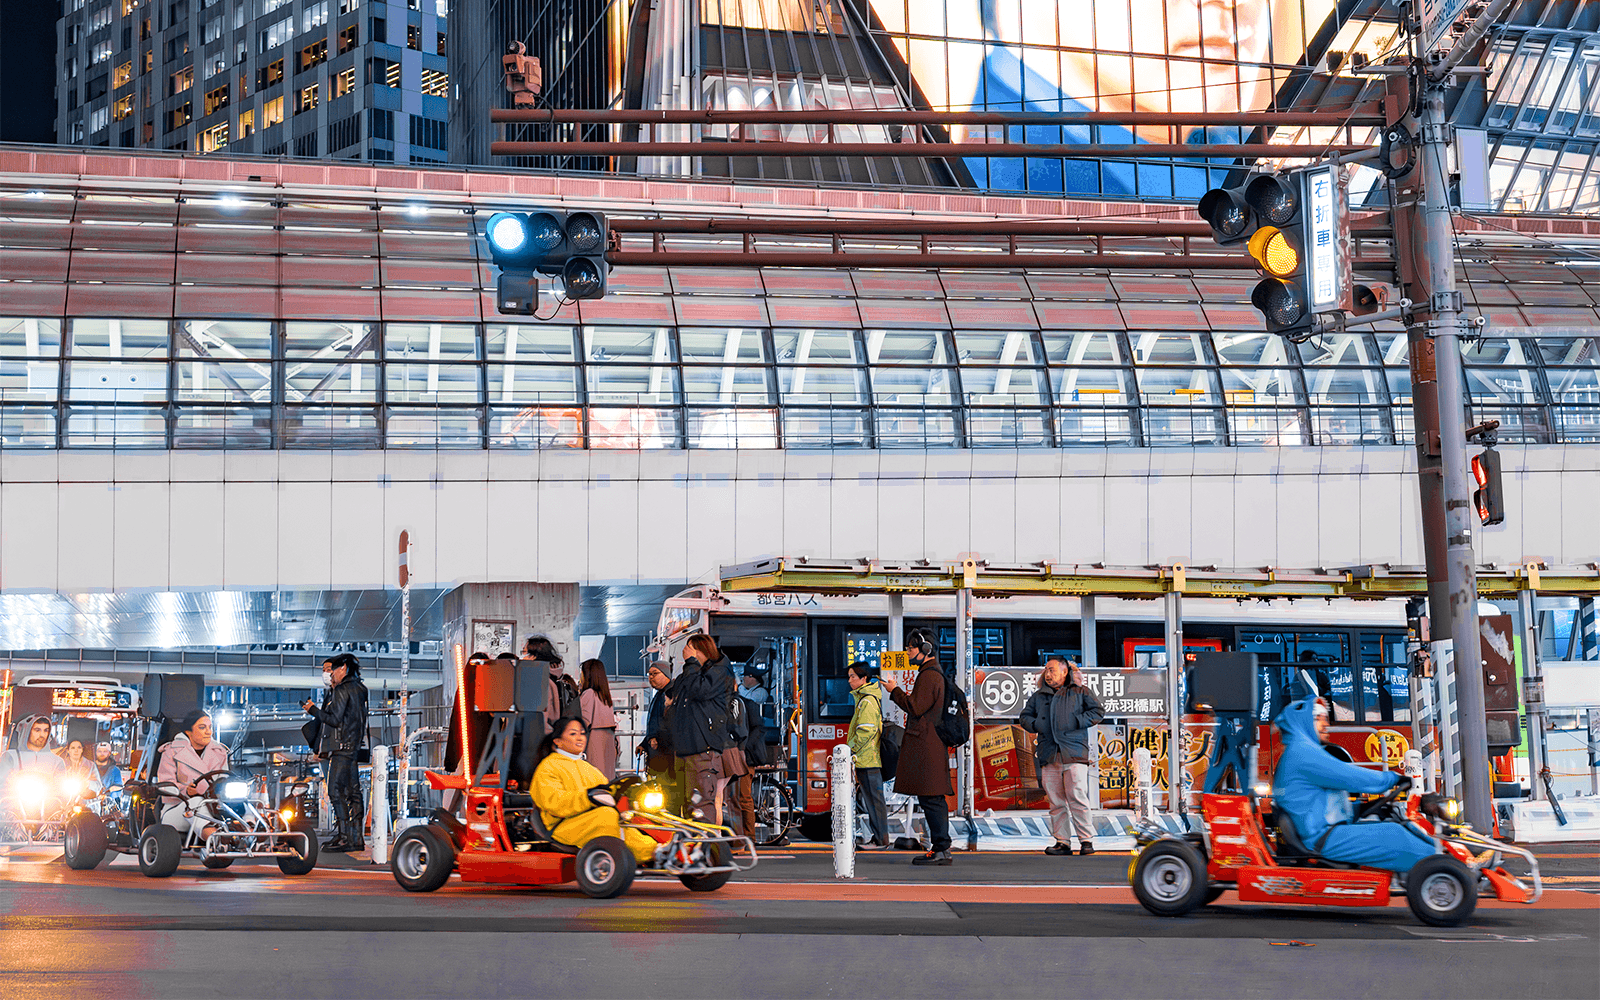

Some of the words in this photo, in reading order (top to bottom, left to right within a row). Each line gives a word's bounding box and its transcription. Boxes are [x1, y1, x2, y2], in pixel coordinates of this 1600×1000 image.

[1315, 179, 1331, 298] 右折車専用
[882, 653, 905, 669] お願
[985, 680, 1016, 706] 58
[1022, 673, 1126, 698] 新駅前
